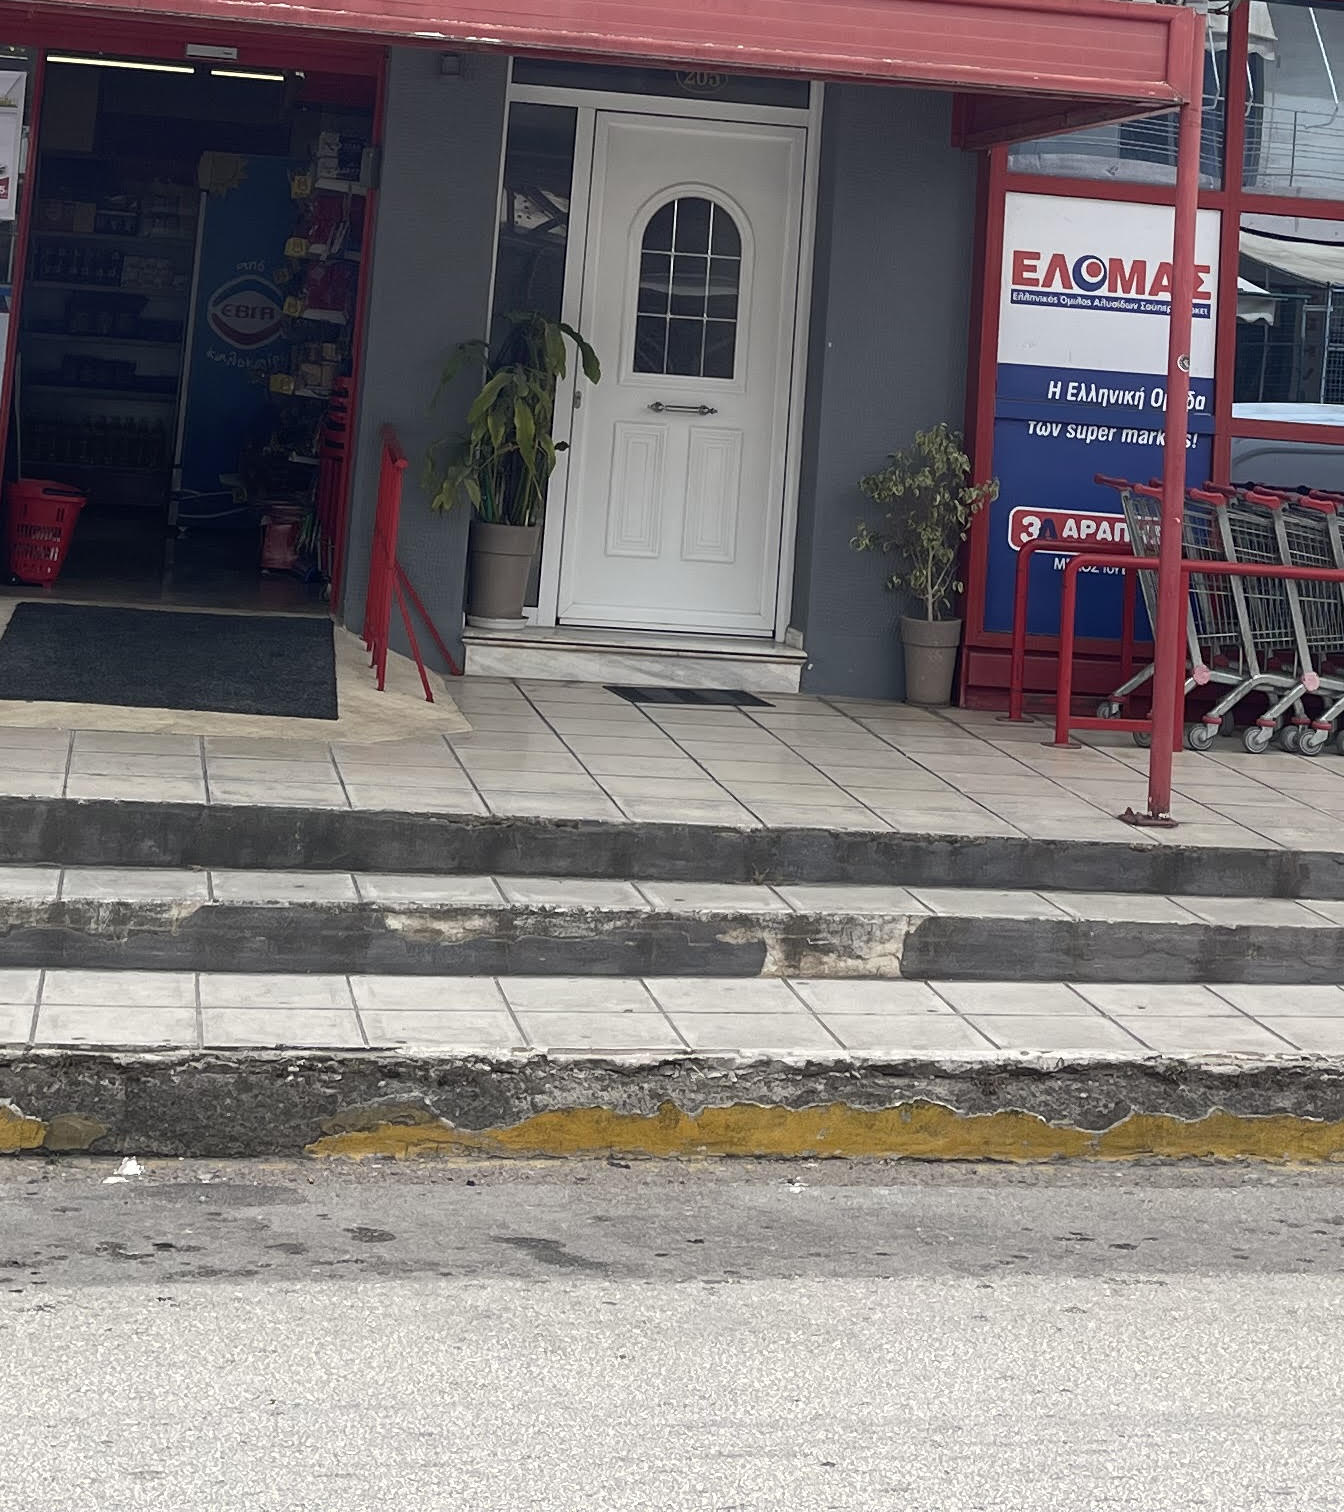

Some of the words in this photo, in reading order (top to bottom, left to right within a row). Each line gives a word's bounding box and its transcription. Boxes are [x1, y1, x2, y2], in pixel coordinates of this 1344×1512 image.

[1048, 381, 1061, 400] Η
[1066, 382, 1146, 410] Ελληνική
[1028, 421, 1061, 437] των
[1066, 424, 1116, 444] super
[1121, 428, 1198, 449] marks!
